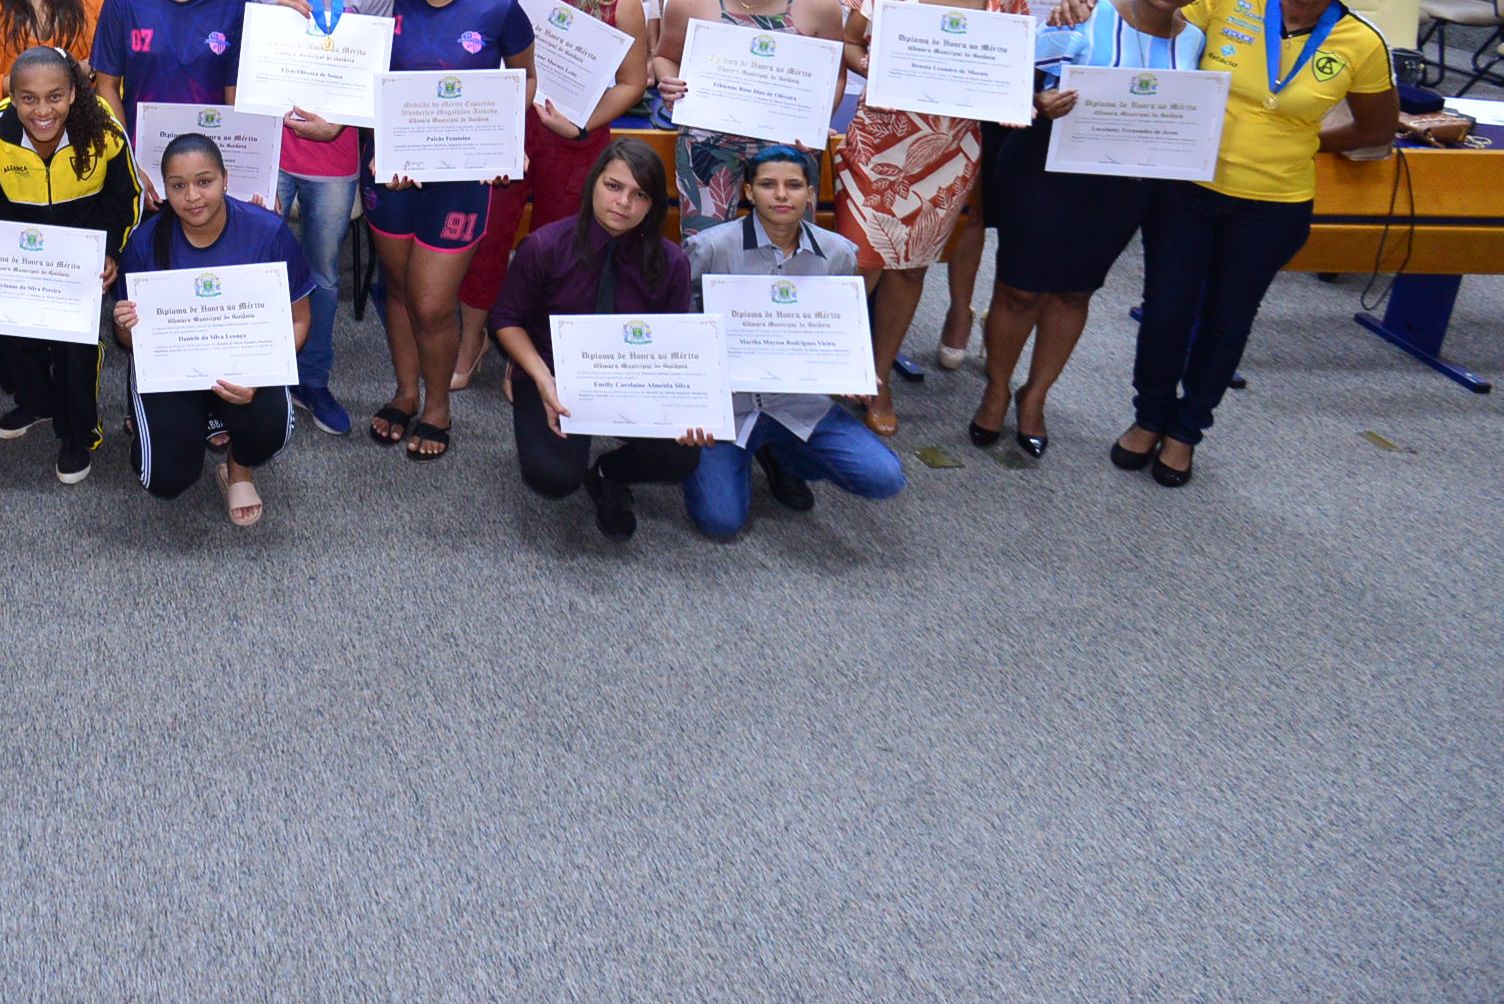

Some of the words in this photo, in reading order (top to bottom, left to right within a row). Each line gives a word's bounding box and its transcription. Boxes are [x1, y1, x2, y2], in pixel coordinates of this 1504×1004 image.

[131, 28, 154, 52] 07
[899, 35, 928, 45] Diploma
[943, 39, 966, 49] Honra
[981, 44, 1007, 53] Mérito
[342, 47, 366, 56] Mérito
[751, 60, 773, 72] Honra
[787, 67, 812, 78] Mérito
[1085, 100, 1116, 109] Diploma
[1131, 102, 1155, 110] Honra
[1170, 103, 1196, 111] Mérito
[3, 165, 28, 173] ALIANÇA
[440, 212, 477, 242] 91
[22, 257, 43, 266] Honra
[57, 260, 80, 269] Mérito
[156, 307, 187, 316] Diploma
[201, 304, 224, 312] Honra
[239, 302, 264, 310] Mérito
[731, 310, 762, 319] Diploma
[776, 310, 800, 318] Honra
[814, 310, 841, 319] Mérito
[581, 352, 614, 361] Diploma
[630, 351, 655, 360] Honra
[671, 352, 699, 360] Mérito
